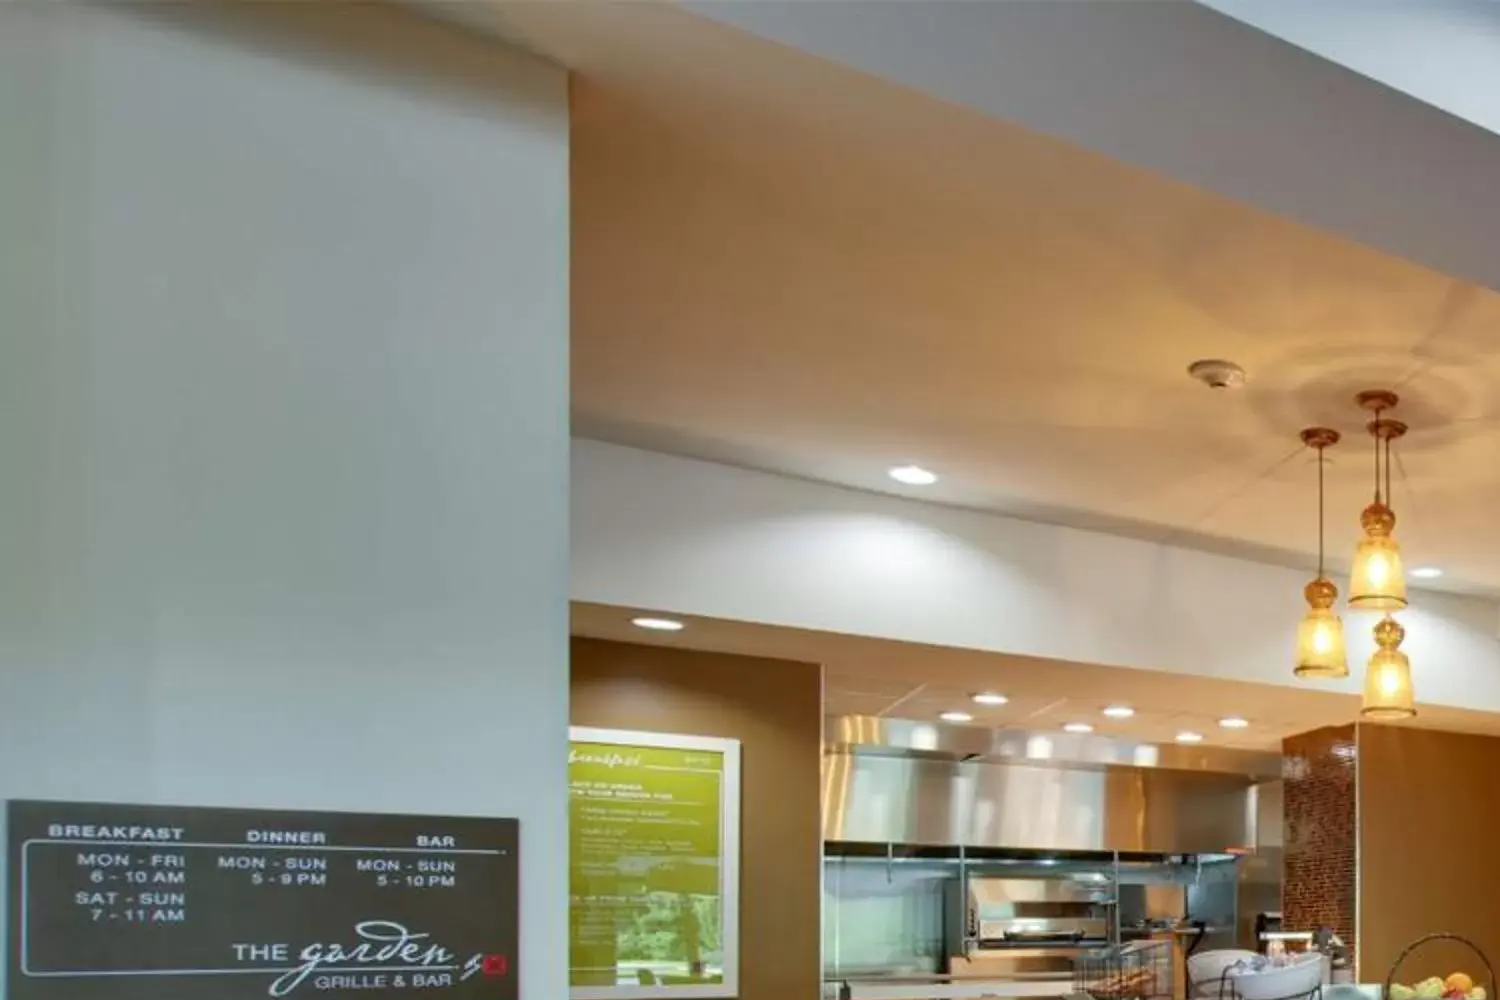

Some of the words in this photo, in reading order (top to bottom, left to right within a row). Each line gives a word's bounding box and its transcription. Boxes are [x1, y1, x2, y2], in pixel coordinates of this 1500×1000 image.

[48, 824, 184, 840] BREAKFAST
[247, 830, 326, 844] DINNER
[416, 835, 456, 847] BAR
[77, 853, 129, 866] MON
[151, 854, 185, 867] FRI
[218, 856, 265, 869] MON
[286, 858, 327, 870] SUN
[357, 859, 400, 871] MON
[418, 860, 456, 872] SUN
[90, 869, 104, 883] 6
[125, 870, 147, 883] 10
[152, 871, 185, 884] AM
[252, 873, 263, 885] 5
[281, 873, 292, 885] 9
[297, 873, 327, 885] PM
[377, 876, 388, 887] 5
[407, 876, 426, 887] 10
[429, 876, 456, 887] PM
[75, 891, 119, 905] SAT
[139, 892, 185, 905] SUN
[91, 908, 103, 921] 7
[125, 909, 144, 921] 11
[152, 909, 185, 921] AM
[232, 943, 289, 961] THE
[268, 920, 455, 997] garden
[315, 976, 387, 989] GRILLE
[392, 976, 405, 988] &
[413, 974, 452, 987] BAR
